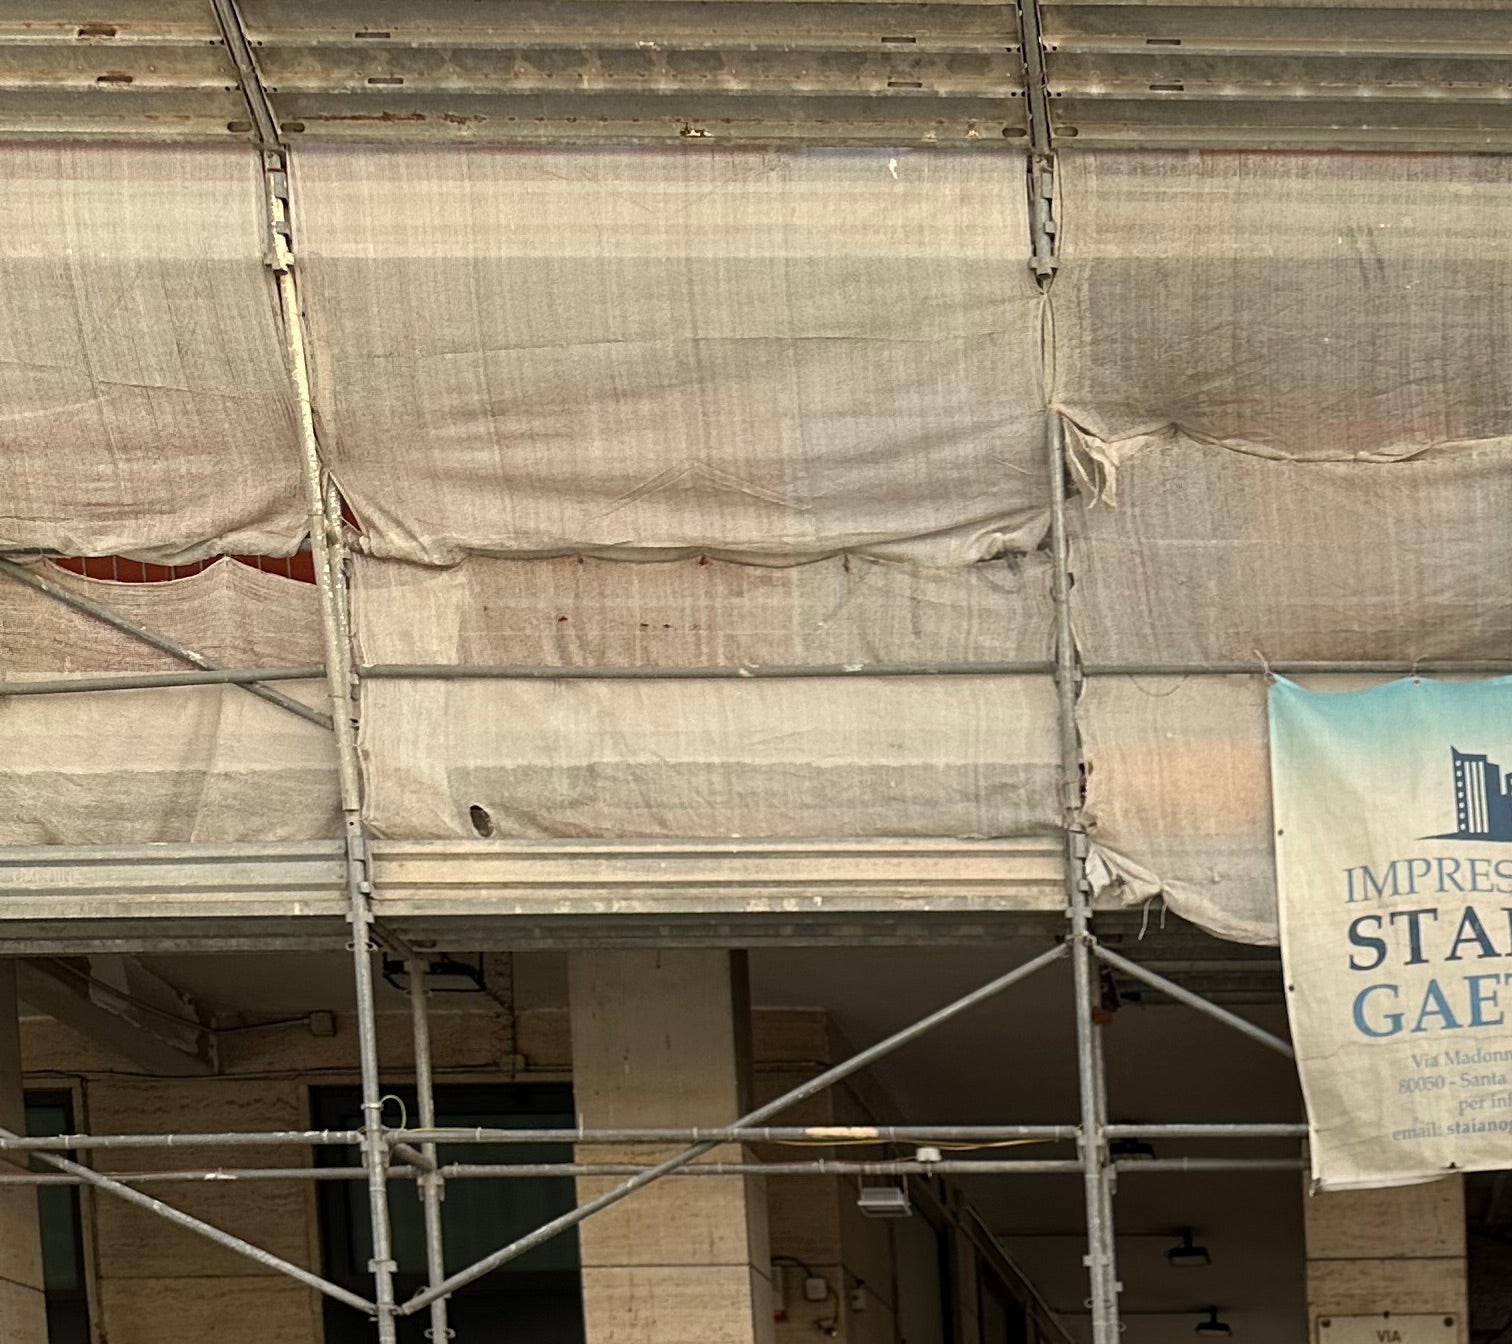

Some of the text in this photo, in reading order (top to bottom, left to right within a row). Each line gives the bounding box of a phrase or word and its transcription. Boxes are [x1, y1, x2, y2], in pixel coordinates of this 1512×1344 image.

[1411, 1053, 1438, 1069] Via
[1459, 1071, 1507, 1089] Santa
[1458, 1100, 1488, 1116] per
[1376, 1329, 1402, 1343] VIA
